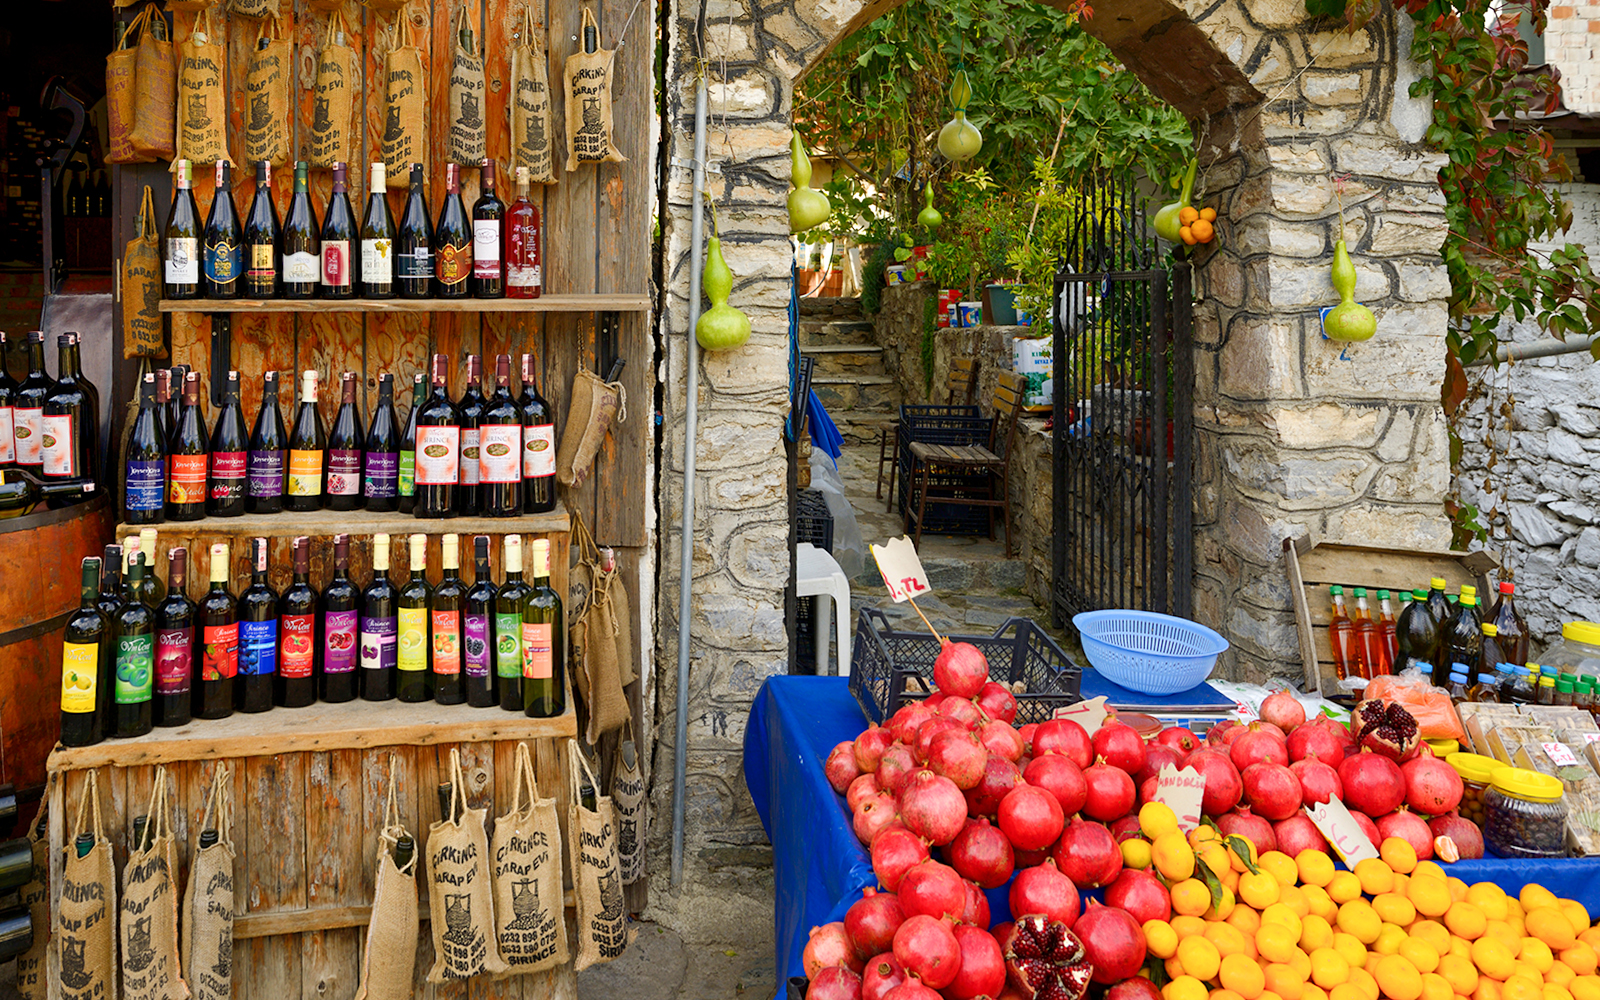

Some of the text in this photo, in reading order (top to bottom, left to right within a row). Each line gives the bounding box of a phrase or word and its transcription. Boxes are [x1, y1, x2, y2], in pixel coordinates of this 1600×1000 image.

[496, 862, 532, 879] ŞARAP
[86, 903, 105, 930] EVİ
[592, 919, 610, 935] 0232
[500, 933, 520, 944] 0232
[522, 931, 538, 944] 898
[454, 946, 469, 959] 898
[501, 944, 522, 955] 0532
[524, 942, 539, 955] 580
[455, 959, 469, 972] 580
[94, 980, 104, 996] 01
